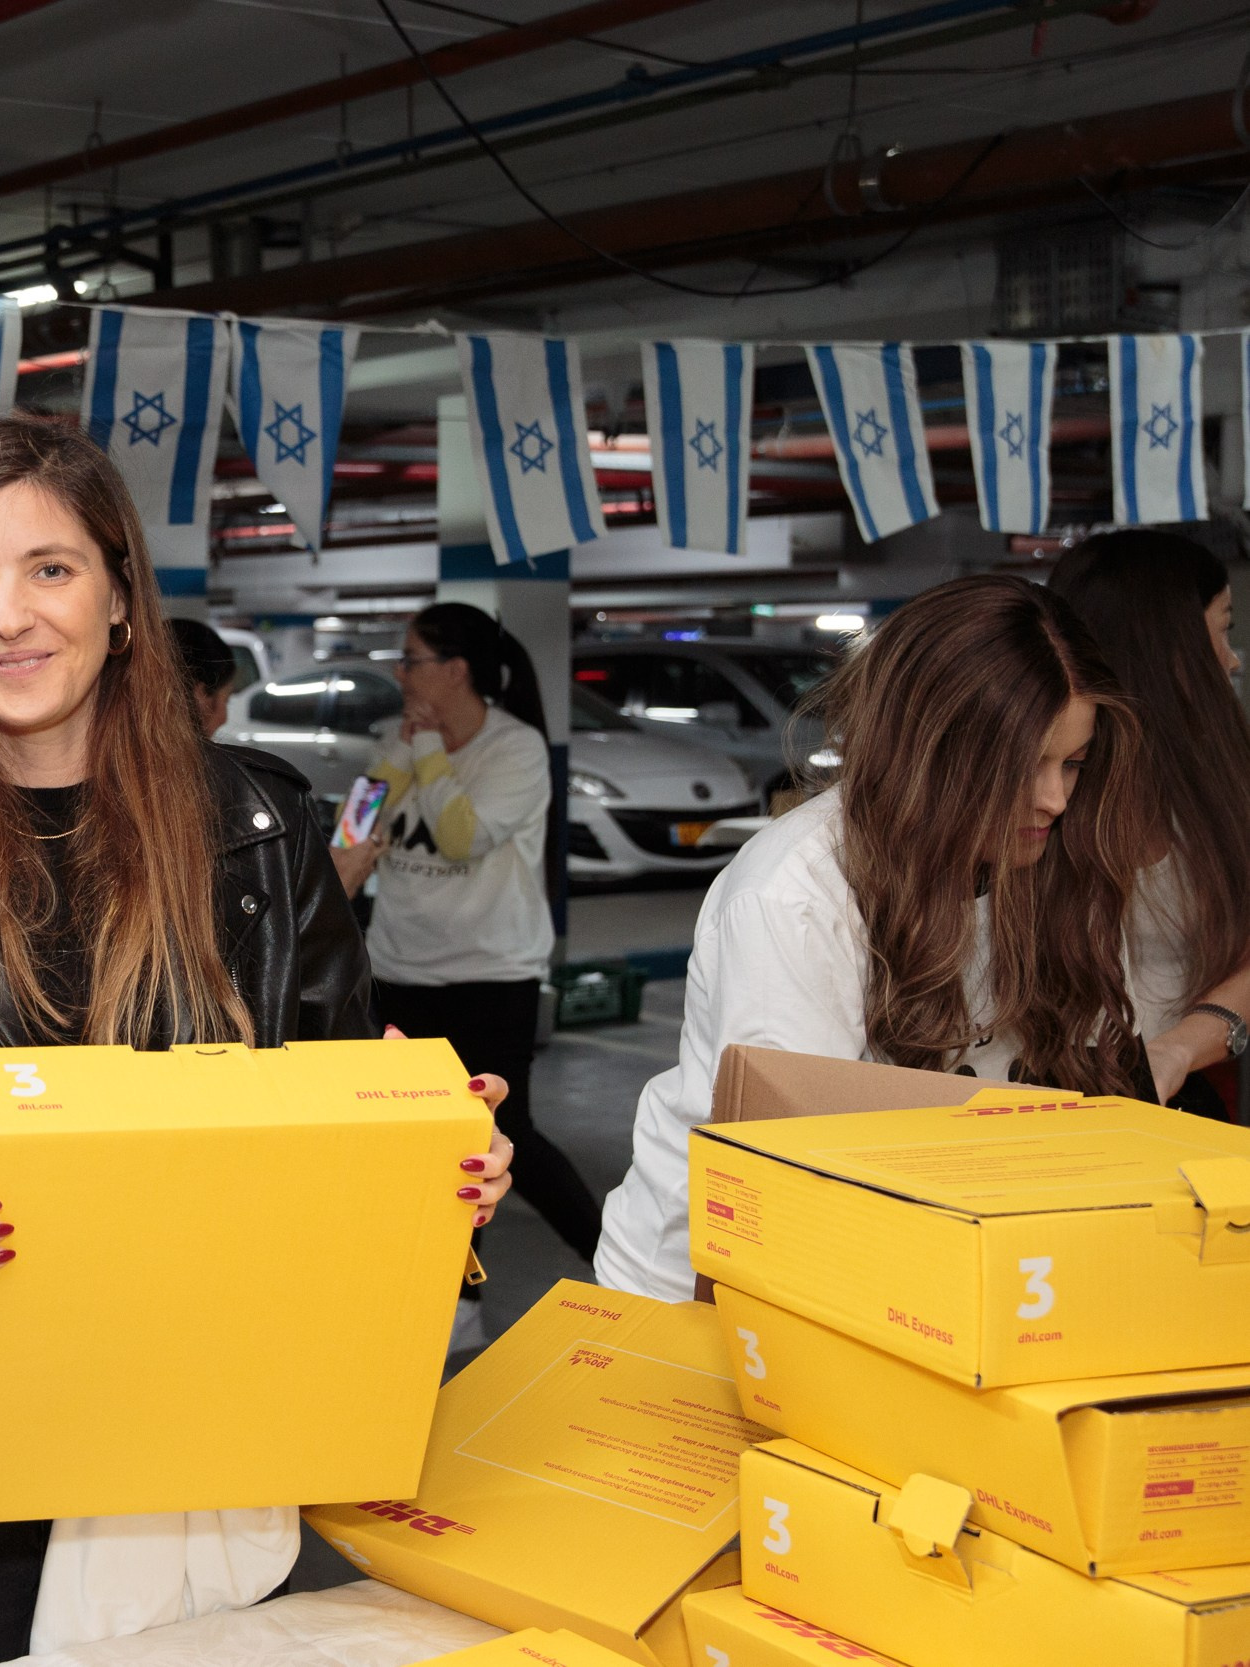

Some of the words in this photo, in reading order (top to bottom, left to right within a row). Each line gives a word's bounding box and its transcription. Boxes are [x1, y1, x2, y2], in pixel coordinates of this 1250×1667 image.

[3, 1062, 46, 1098] 3
[356, 1089, 388, 1101] DHL
[391, 1087, 451, 1101] Express
[18, 1101, 63, 1111] dhl.com
[967, 1101, 1097, 1117] DHL
[1016, 1256, 1055, 1320] 3
[559, 1300, 599, 1315] Express
[600, 1309, 622, 1321] DHL
[887, 1307, 909, 1330] DHL
[910, 1316, 954, 1346] Express
[1017, 1329, 1062, 1345] dhl.com
[736, 1326, 767, 1380] 3
[583, 1356, 609, 1370] 100%
[975, 1488, 1003, 1512] DHL
[1004, 1498, 1053, 1535] Express
[762, 1496, 791, 1555] 3
[765, 1561, 799, 1583] dhl.com
